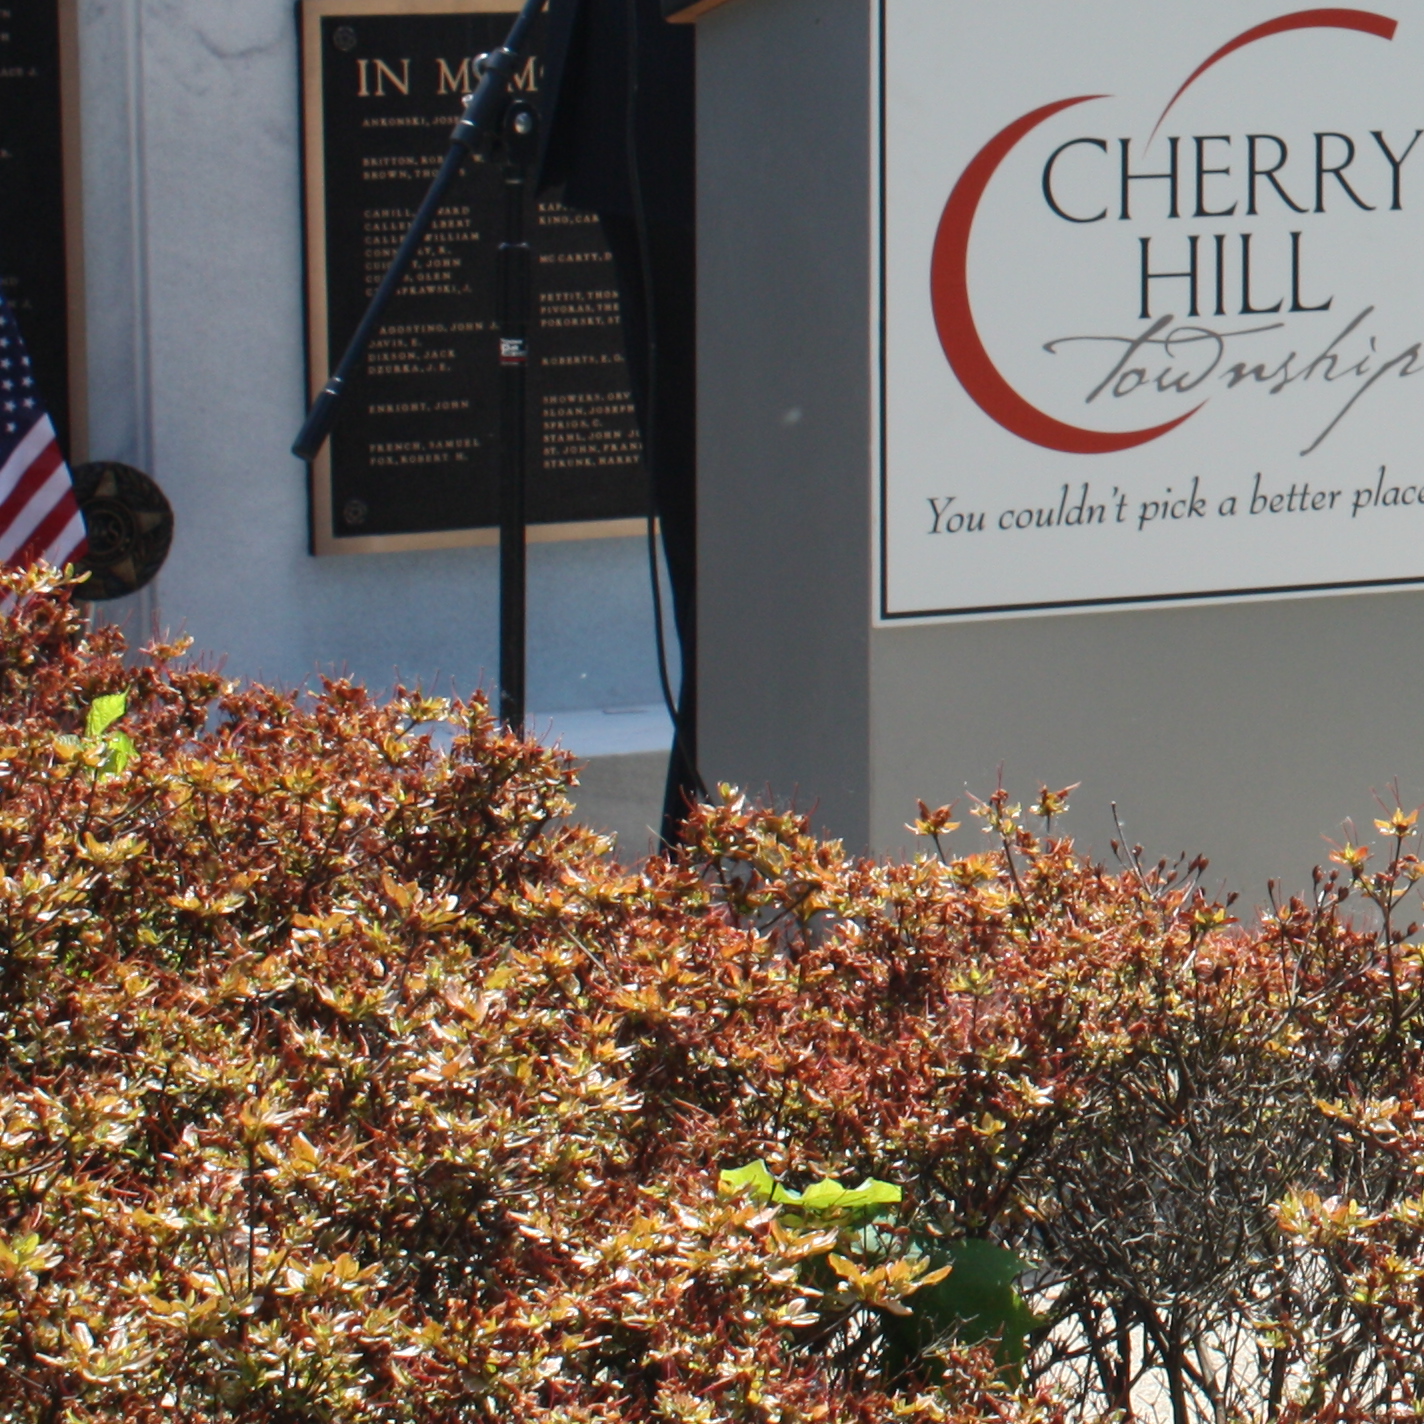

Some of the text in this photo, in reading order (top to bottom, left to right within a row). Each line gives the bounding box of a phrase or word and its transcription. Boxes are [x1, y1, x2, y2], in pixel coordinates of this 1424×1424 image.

[356, 58, 412, 96] IN
[1137, 231, 1334, 319] HILL
[925, 495, 986, 535] You
[997, 483, 1129, 531] couldn't
[1138, 474, 1207, 531] pick
[1217, 494, 1238, 517] a
[1249, 472, 1343, 516] better
